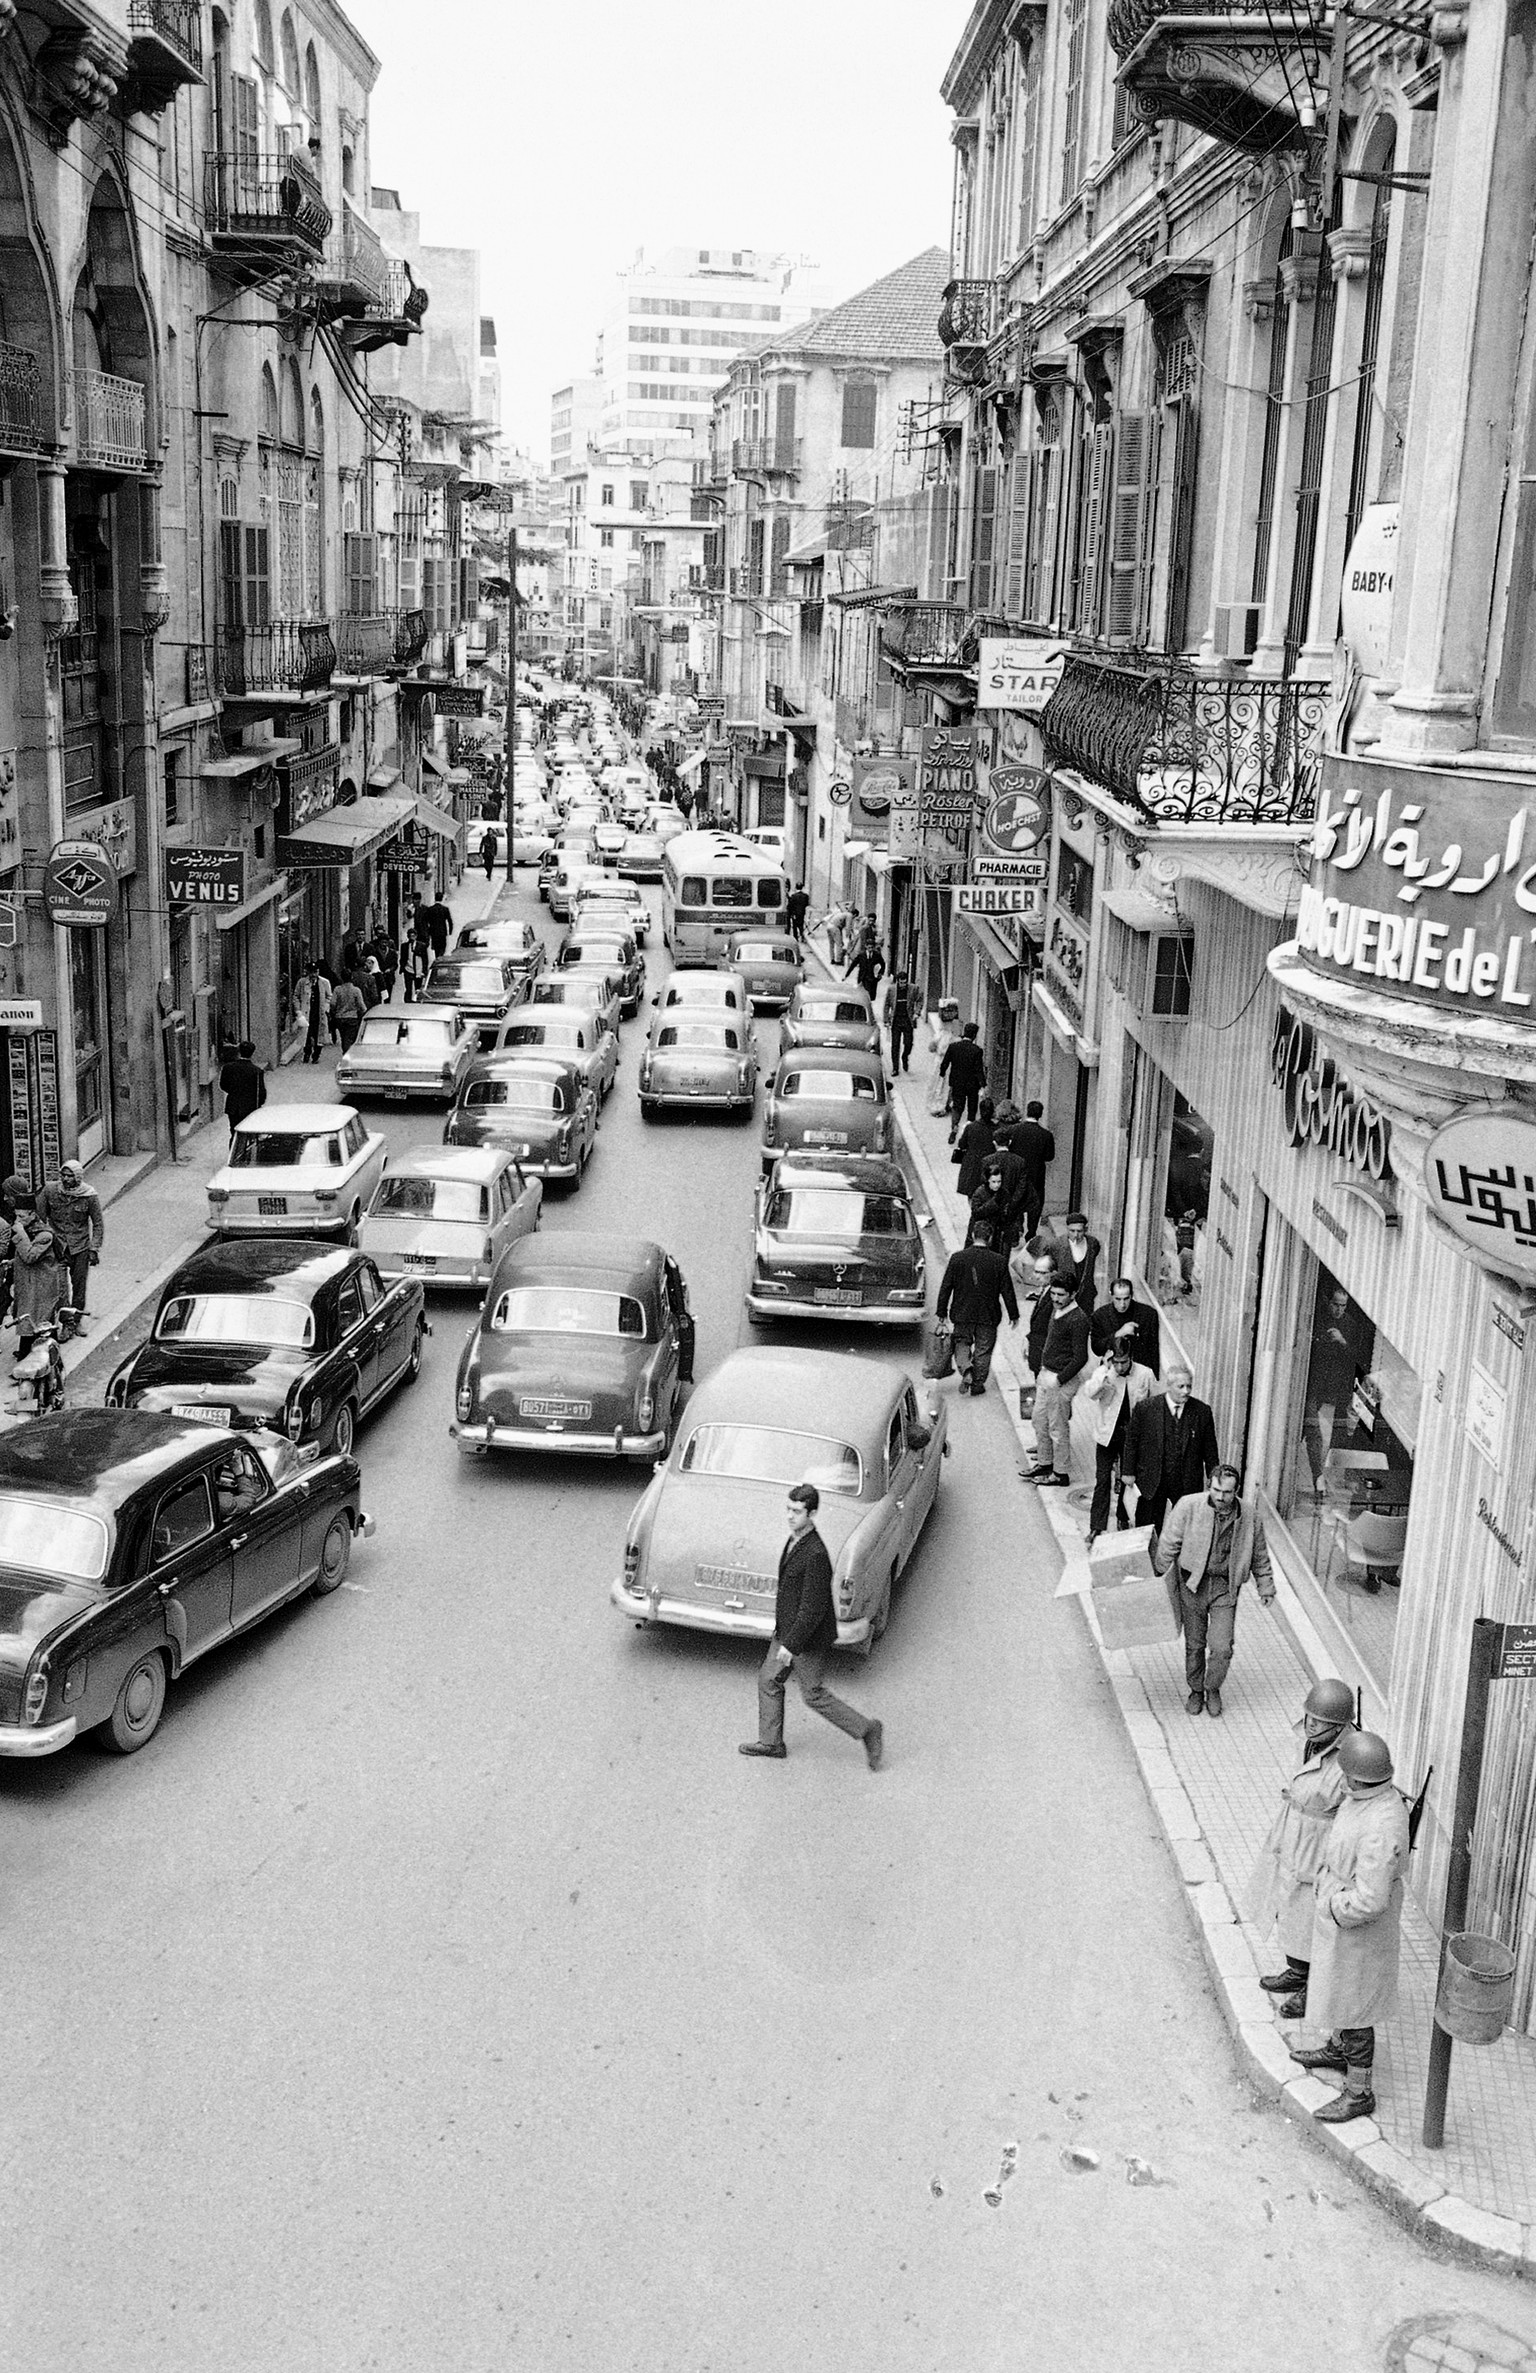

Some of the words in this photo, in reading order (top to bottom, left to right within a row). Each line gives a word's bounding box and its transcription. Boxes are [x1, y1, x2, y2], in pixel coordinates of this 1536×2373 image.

[989, 655, 1062, 671] ستار
[990, 675, 1058, 691] STAR
[1006, 694, 1043, 704] TAILOR
[922, 768, 974, 791] PIANO
[999, 774, 1042, 791] ادوية
[921, 813, 971, 829] PETROF
[997, 811, 1042, 833] HOECHST
[383, 863, 420, 872] DEVELOP
[979, 862, 1042, 875] PHARMACIE
[61, 869, 97, 891] Agfa
[170, 881, 239, 901] VENUS
[49, 896, 70, 905] CINE
[83, 897, 110, 907] PHOTO
[959, 890, 1034, 909] CHAKER
[1445, 927, 1500, 997] de
[0, 1010, 34, 1019] anon
[1503, 1666, 1533, 1676] MINET
